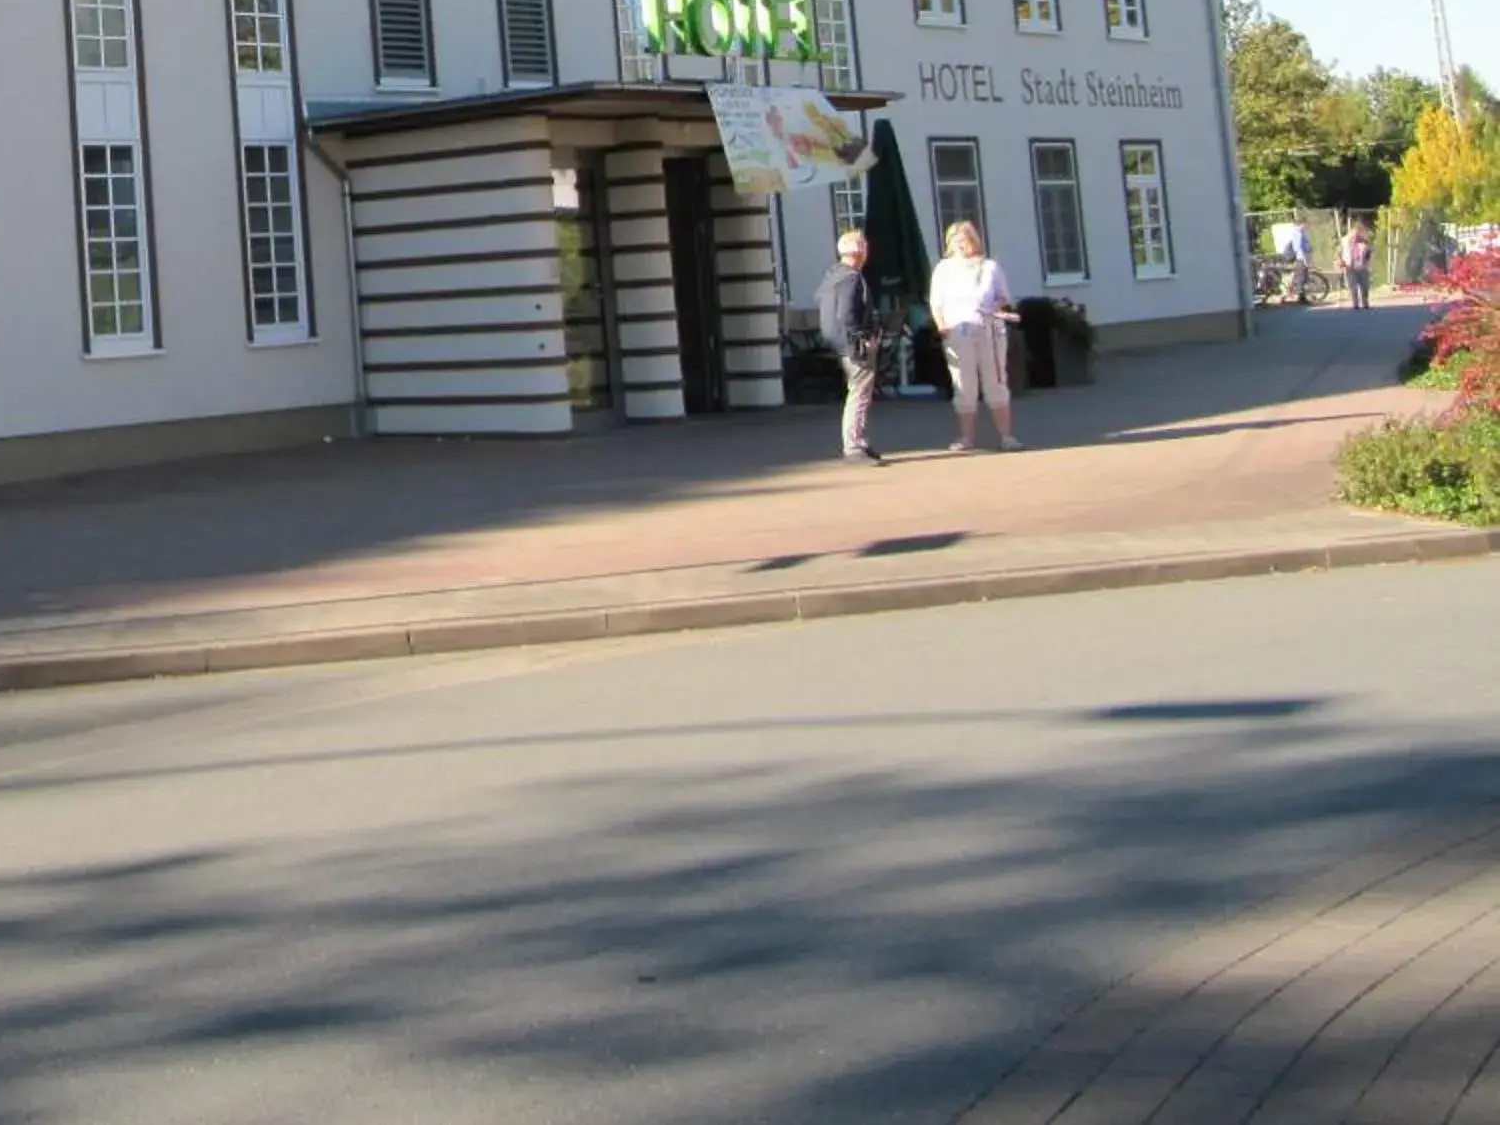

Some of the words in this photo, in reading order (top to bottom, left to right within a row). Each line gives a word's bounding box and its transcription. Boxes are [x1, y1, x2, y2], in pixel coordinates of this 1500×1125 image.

[918, 61, 1004, 104] HOTEL
[1020, 68, 1080, 106] Stadt
[1085, 71, 1184, 109] Steinheim
